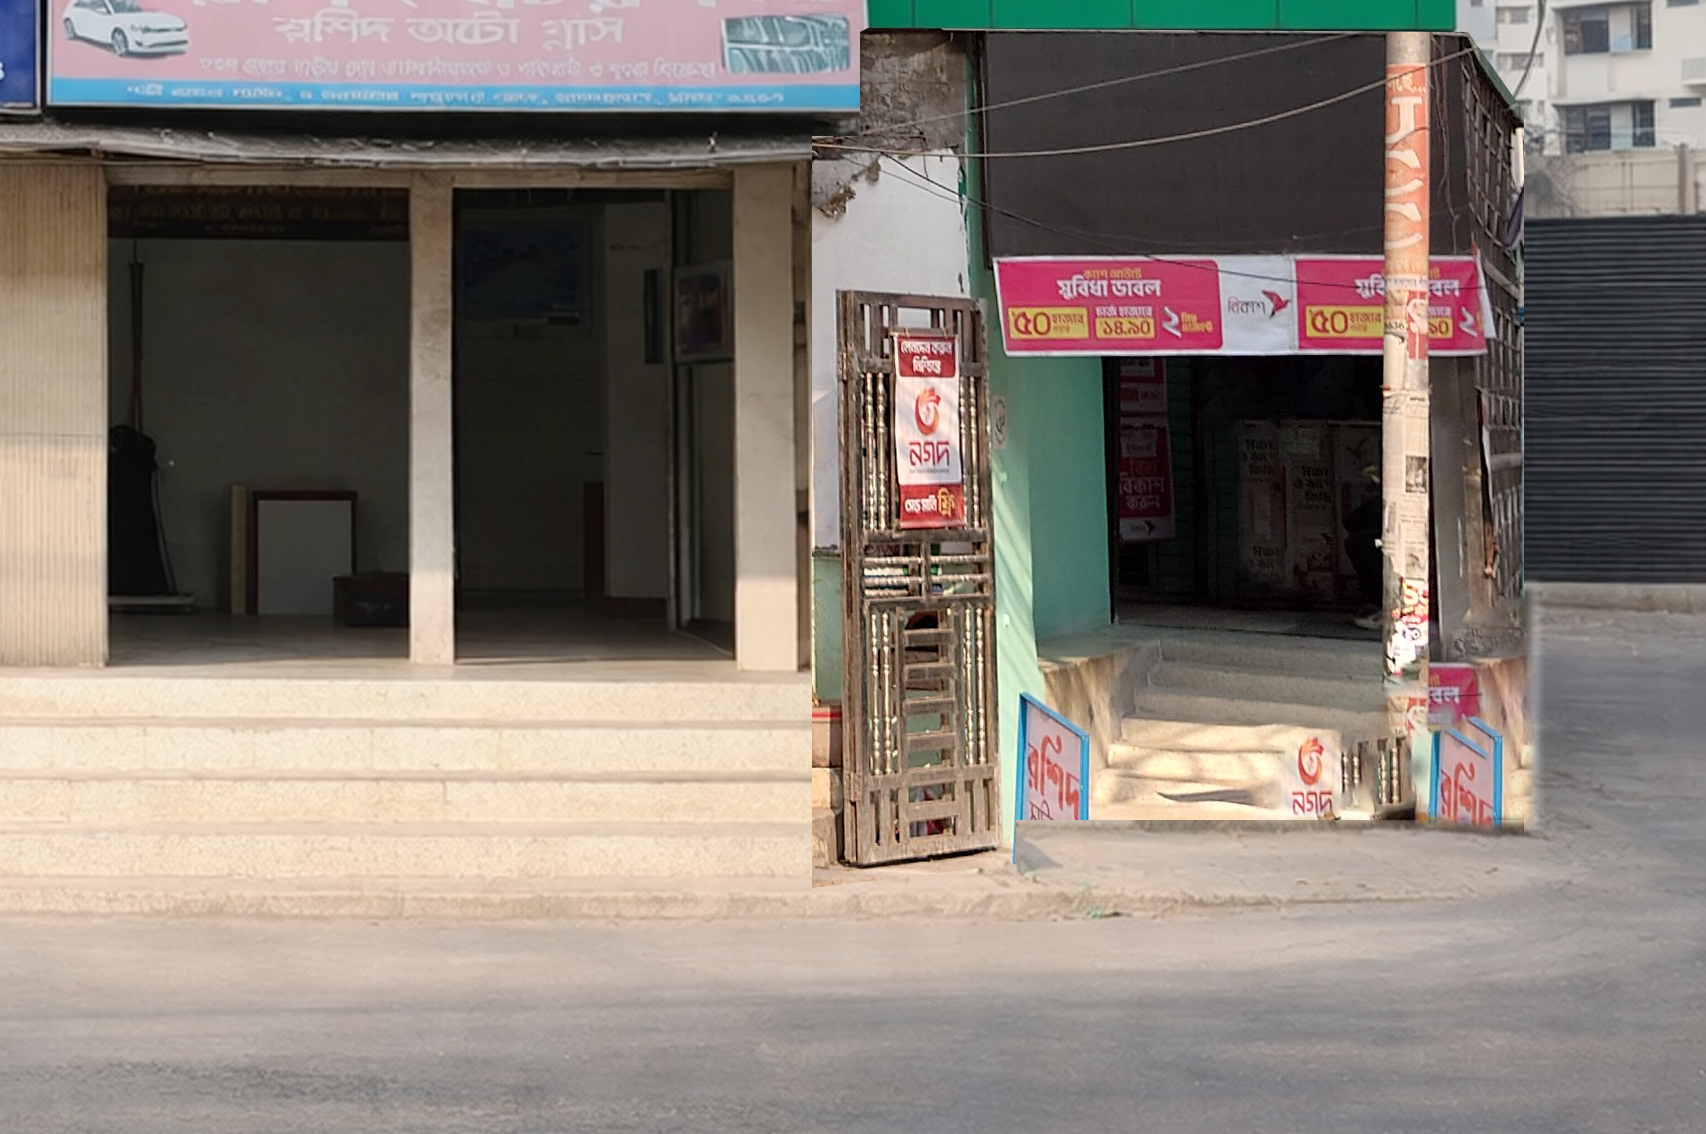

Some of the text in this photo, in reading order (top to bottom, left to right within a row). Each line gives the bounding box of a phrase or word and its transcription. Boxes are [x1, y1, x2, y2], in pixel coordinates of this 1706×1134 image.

[1056, 274, 1161, 300] সুবিধা ডাবল
[909, 441, 949, 466] নগদ
